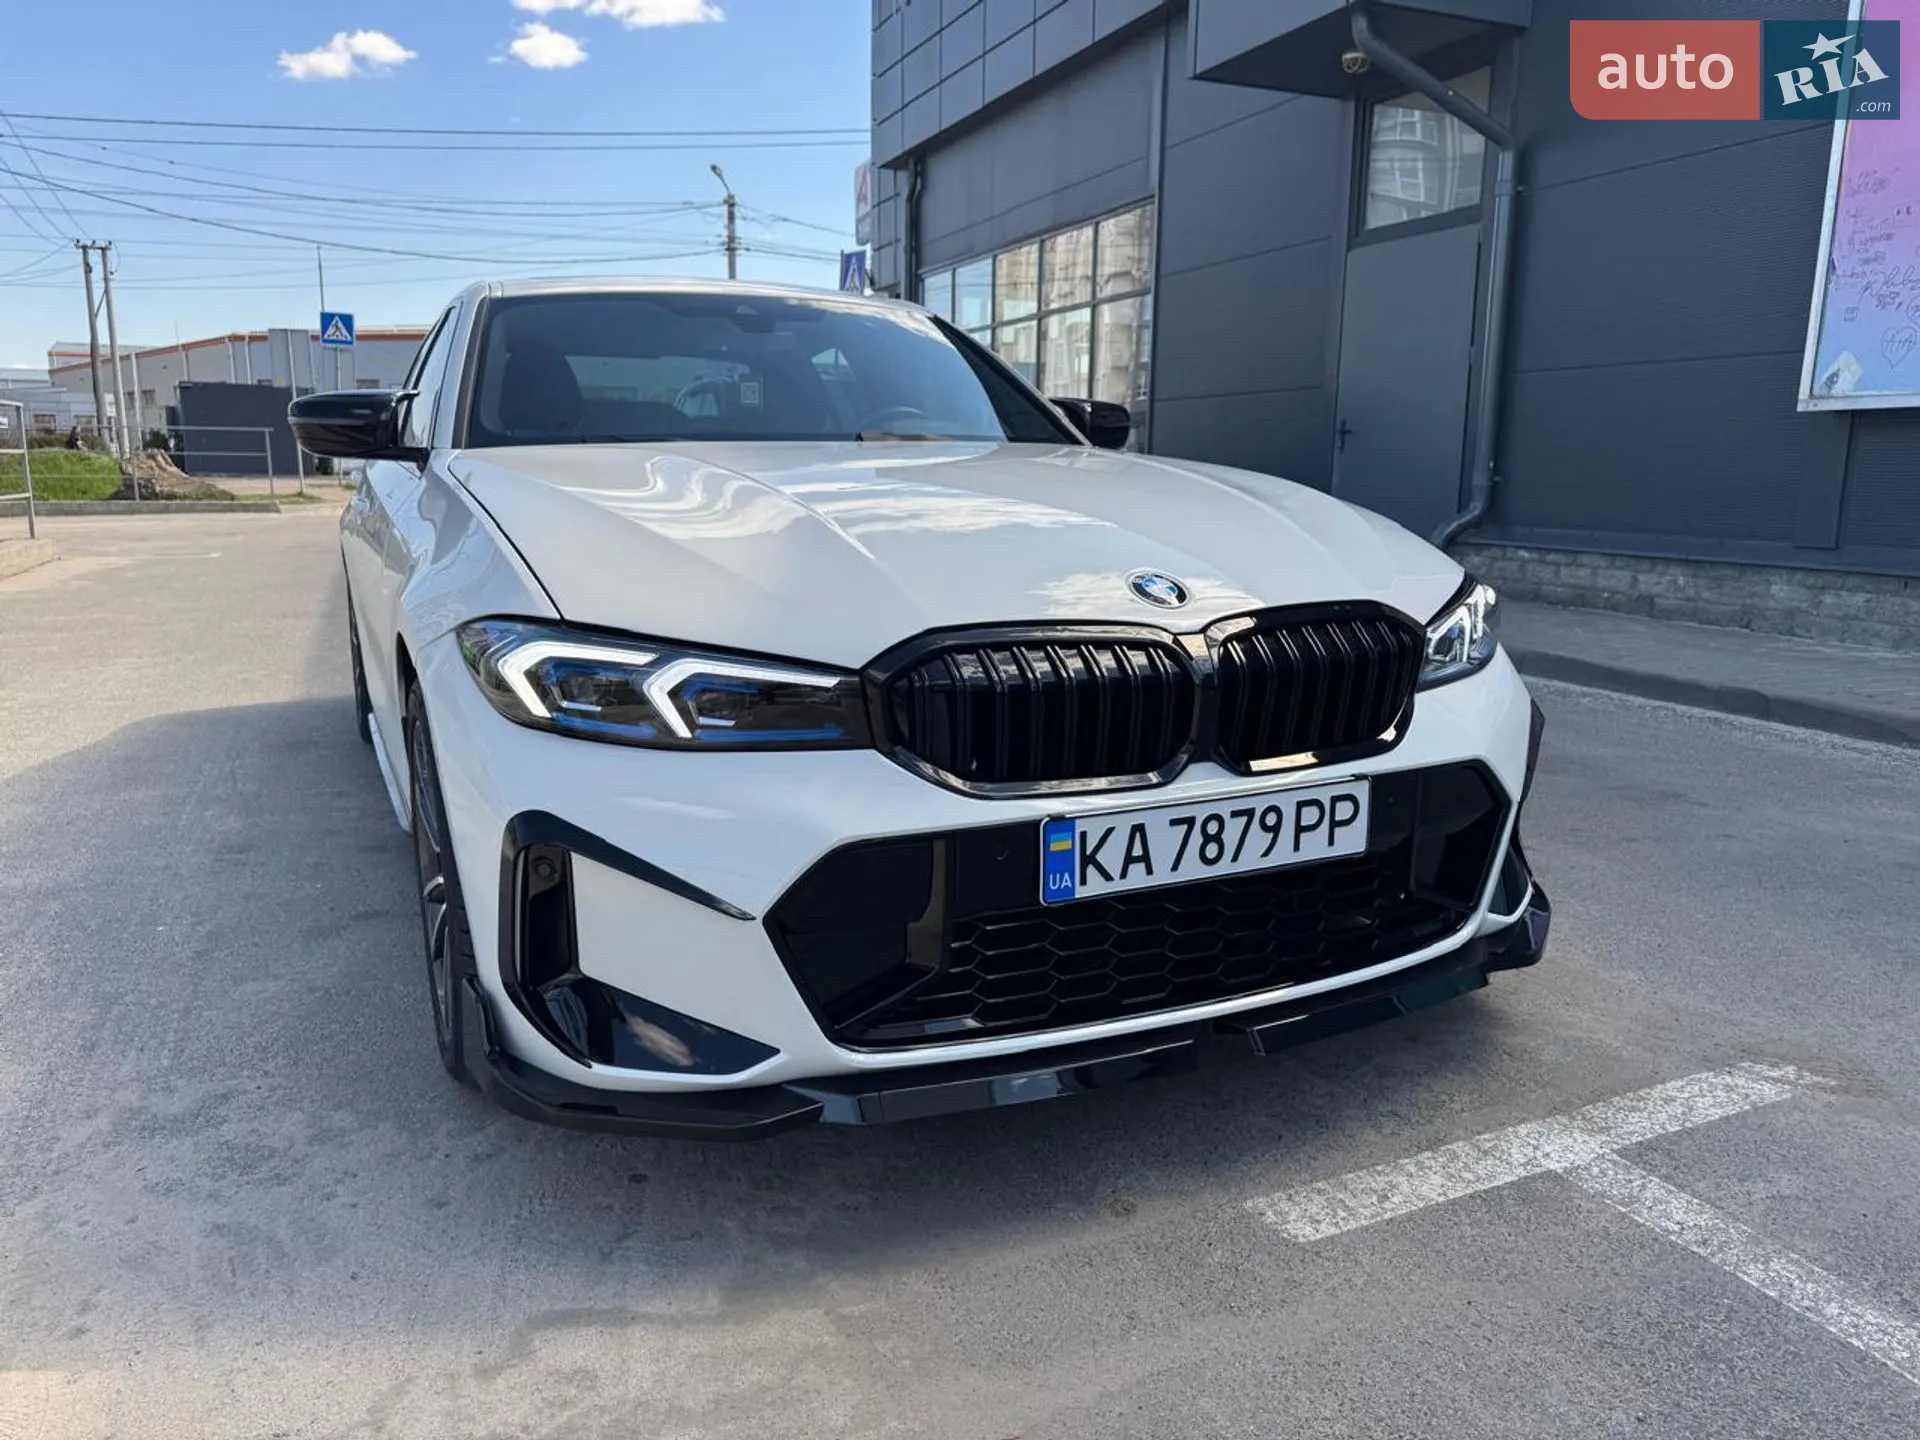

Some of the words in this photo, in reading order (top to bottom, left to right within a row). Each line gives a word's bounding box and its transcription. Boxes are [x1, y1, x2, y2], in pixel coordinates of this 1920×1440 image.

[1079, 823, 1154, 887] KA
[1169, 804, 1284, 873] 7879
[1293, 793, 1360, 853] PP
[1049, 872, 1073, 890] UA
